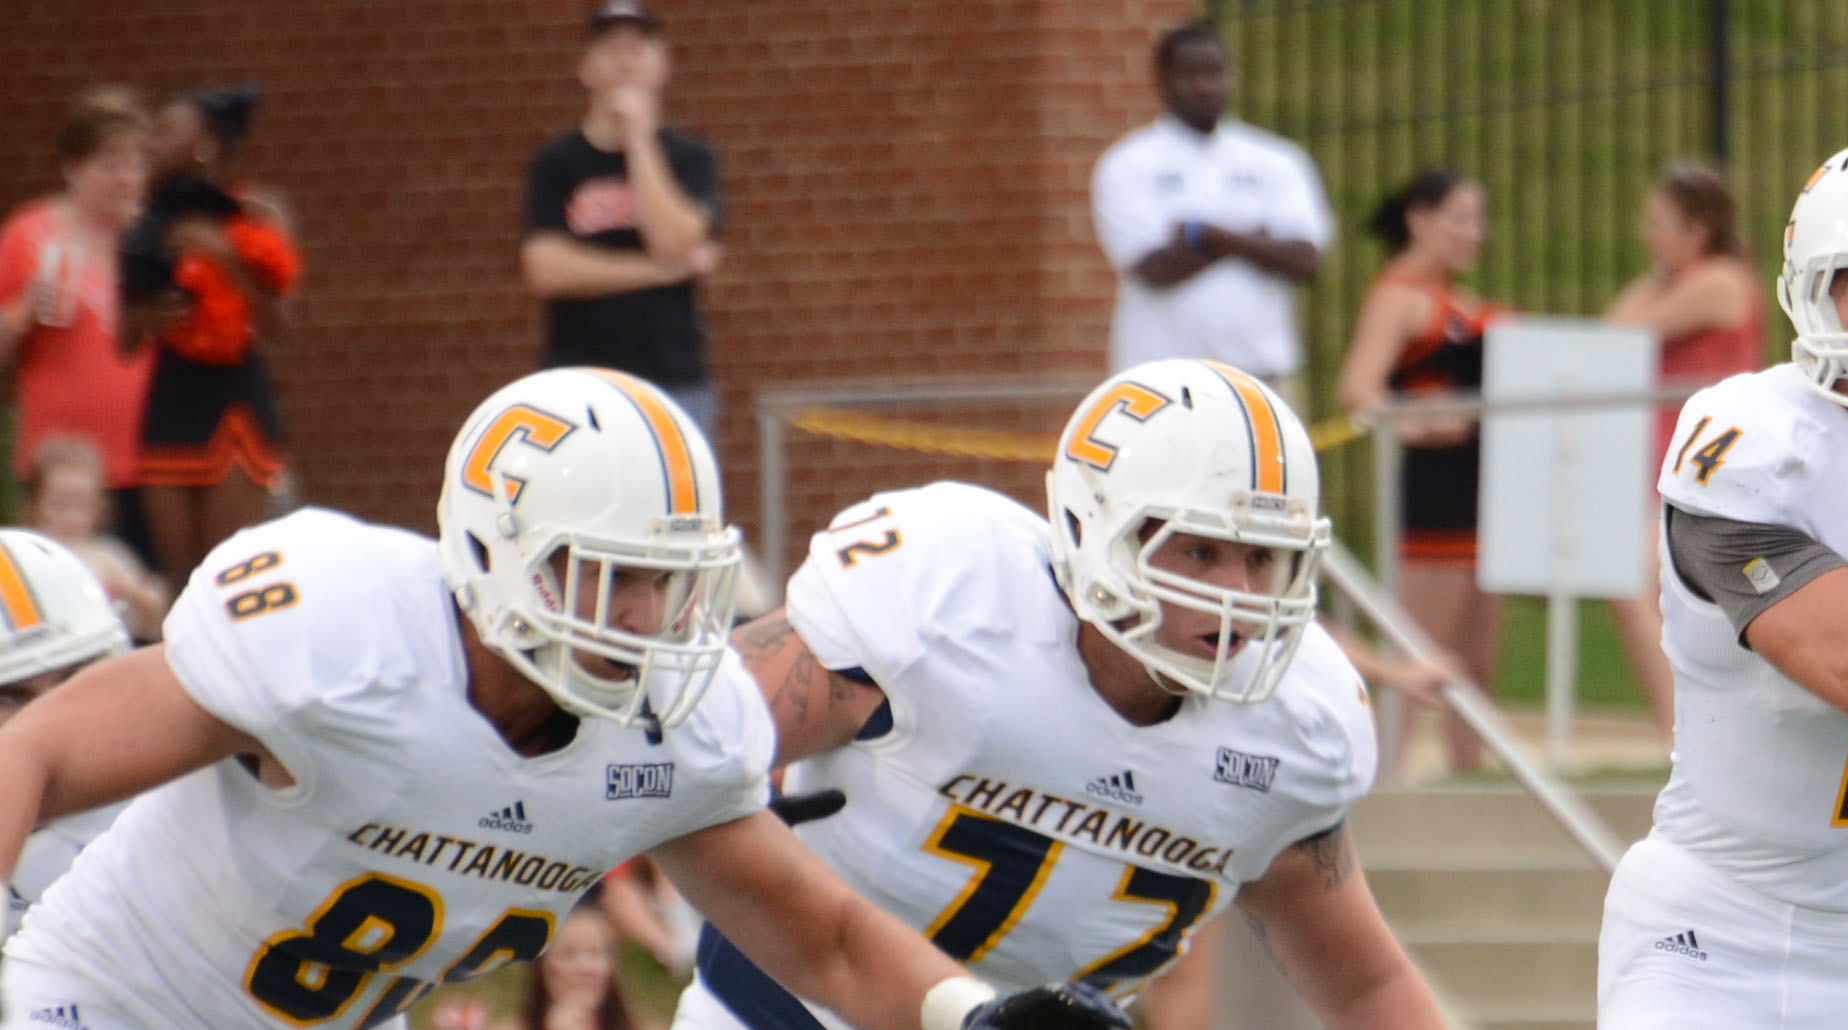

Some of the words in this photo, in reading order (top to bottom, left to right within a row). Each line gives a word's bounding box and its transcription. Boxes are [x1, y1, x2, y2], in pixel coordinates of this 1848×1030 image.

[461, 403, 579, 507] C
[1065, 381, 1173, 473] C
[1672, 415, 1743, 486] 14
[828, 505, 903, 568] 72
[215, 550, 300, 622] 88
[606, 762, 674, 801] SOCON
[1214, 746, 1281, 793] SOCON
[347, 823, 603, 893] CHATTANOOGA
[478, 816, 533, 835] adidas
[938, 774, 1235, 875] CHATTANOOGA
[1654, 939, 1709, 962] adidas
